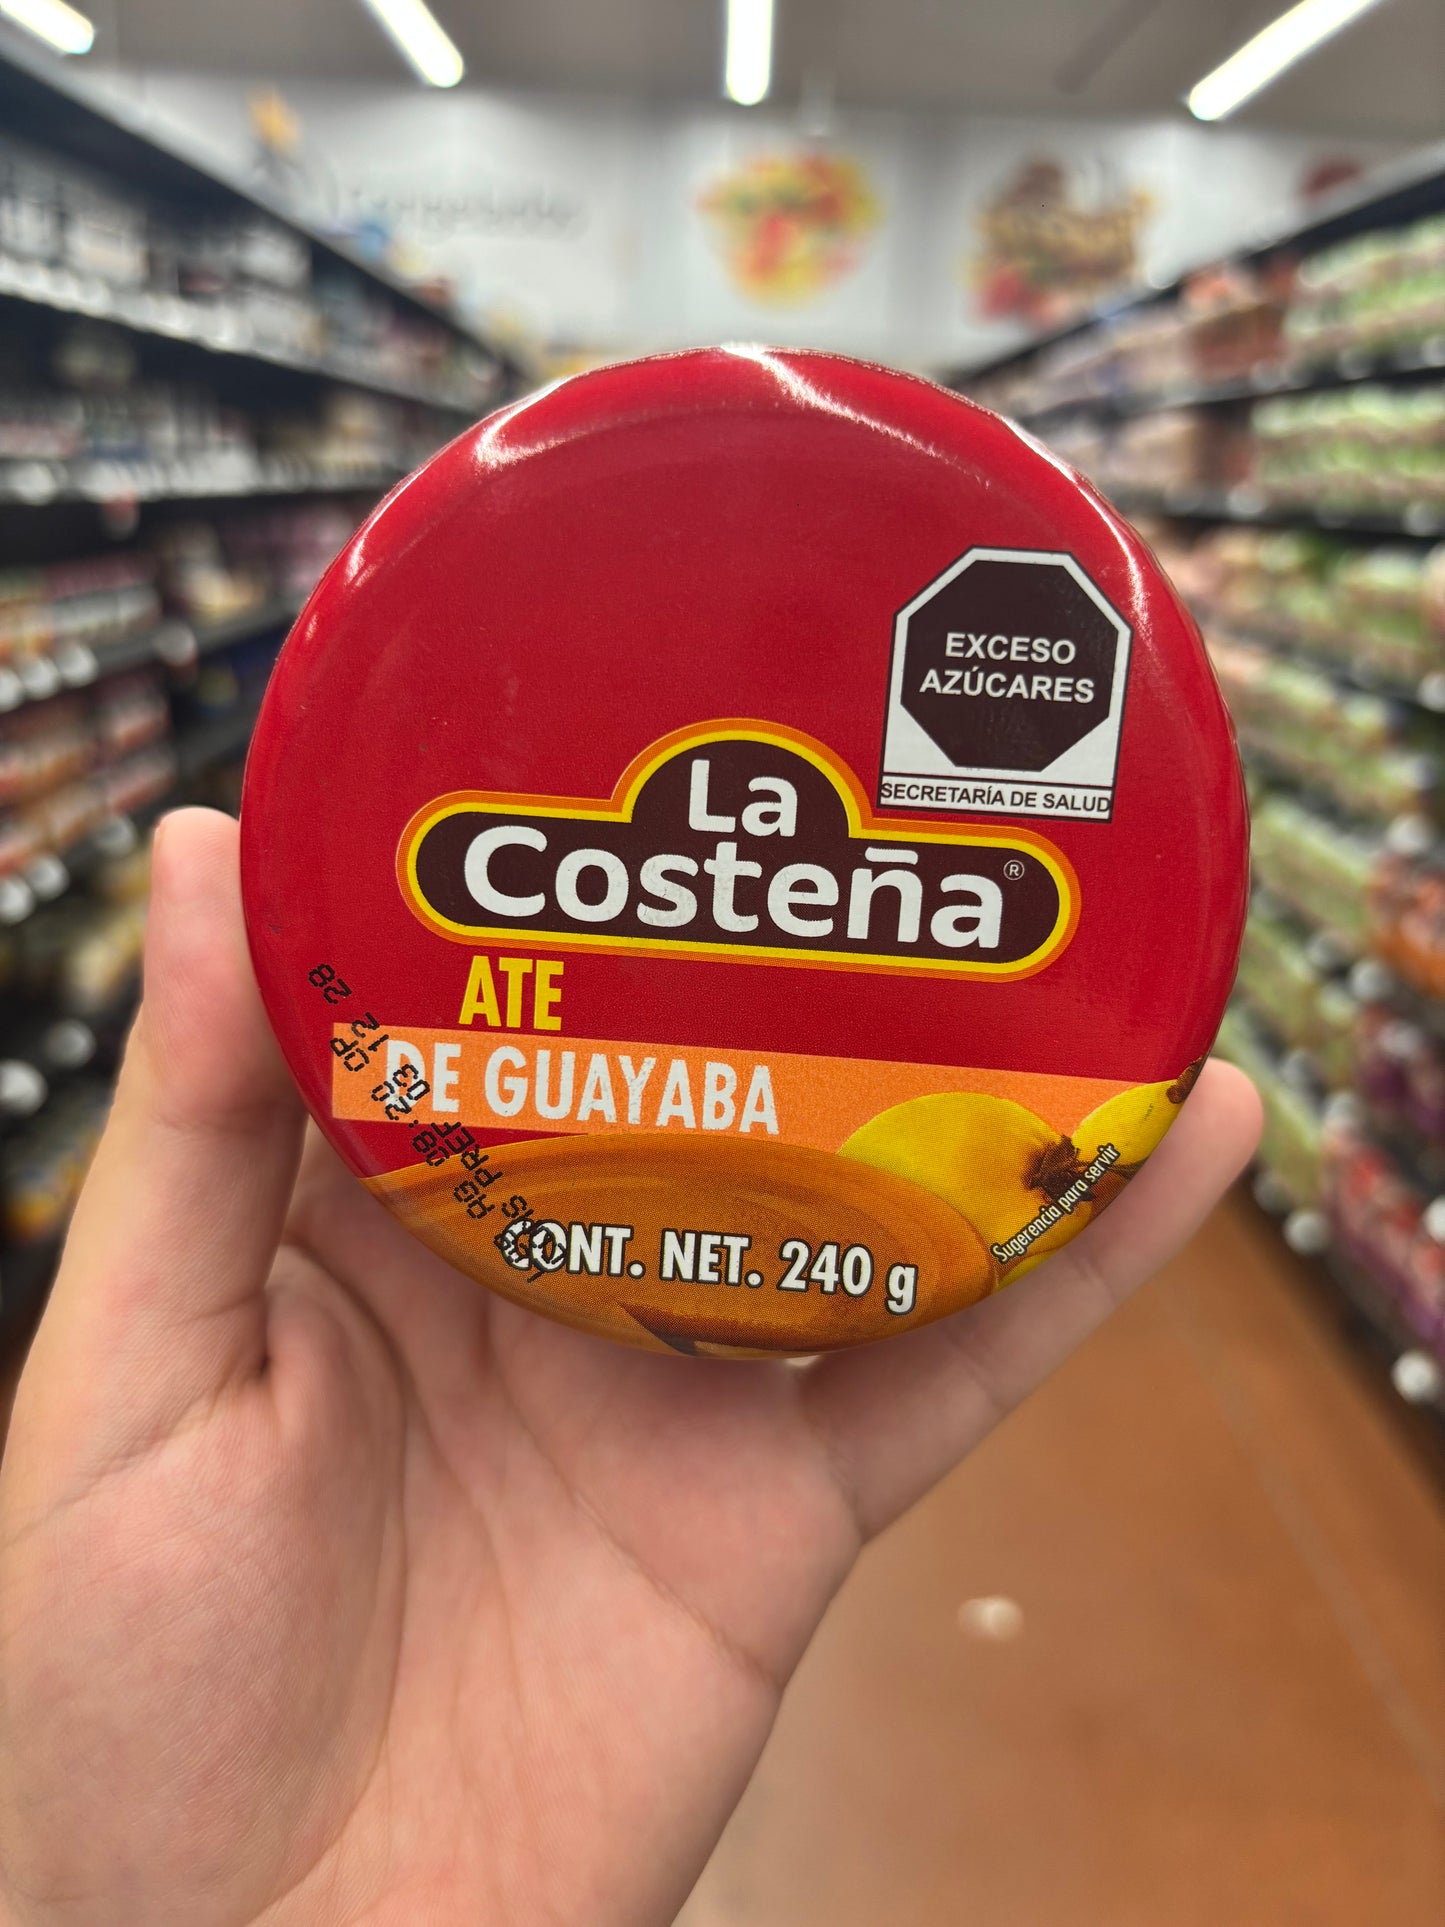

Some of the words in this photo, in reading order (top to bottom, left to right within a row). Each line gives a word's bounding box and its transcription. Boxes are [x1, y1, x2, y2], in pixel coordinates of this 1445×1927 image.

[945, 632, 1076, 665] EXCESO
[919, 667, 1095, 704] AZÚCARES
[687, 758, 798, 837] La
[880, 782, 1005, 807] SECRETARÍA
[1010, 790, 1037, 808] DE
[1042, 792, 1110, 814] SALUD
[463, 824, 1004, 949] Costeña
[308, 963, 353, 1004] 28
[458, 955, 565, 1031] ATE
[350, 1012, 390, 1052] 12
[386, 1039, 462, 1114] DE
[484, 1045, 780, 1135] GUAYABA
[392, 1063, 431, 1101] 03
[431, 1121, 503, 1188] PREF
[991, 1204, 1063, 1263] Sugerencia
[1056, 1178, 1090, 1213] para
[1083, 1144, 1120, 1184] servir
[501, 1218, 646, 1279] CONT.
[659, 1227, 764, 1288] NET.
[777, 1239, 875, 1298] 240
[885, 1262, 919, 1315] g
